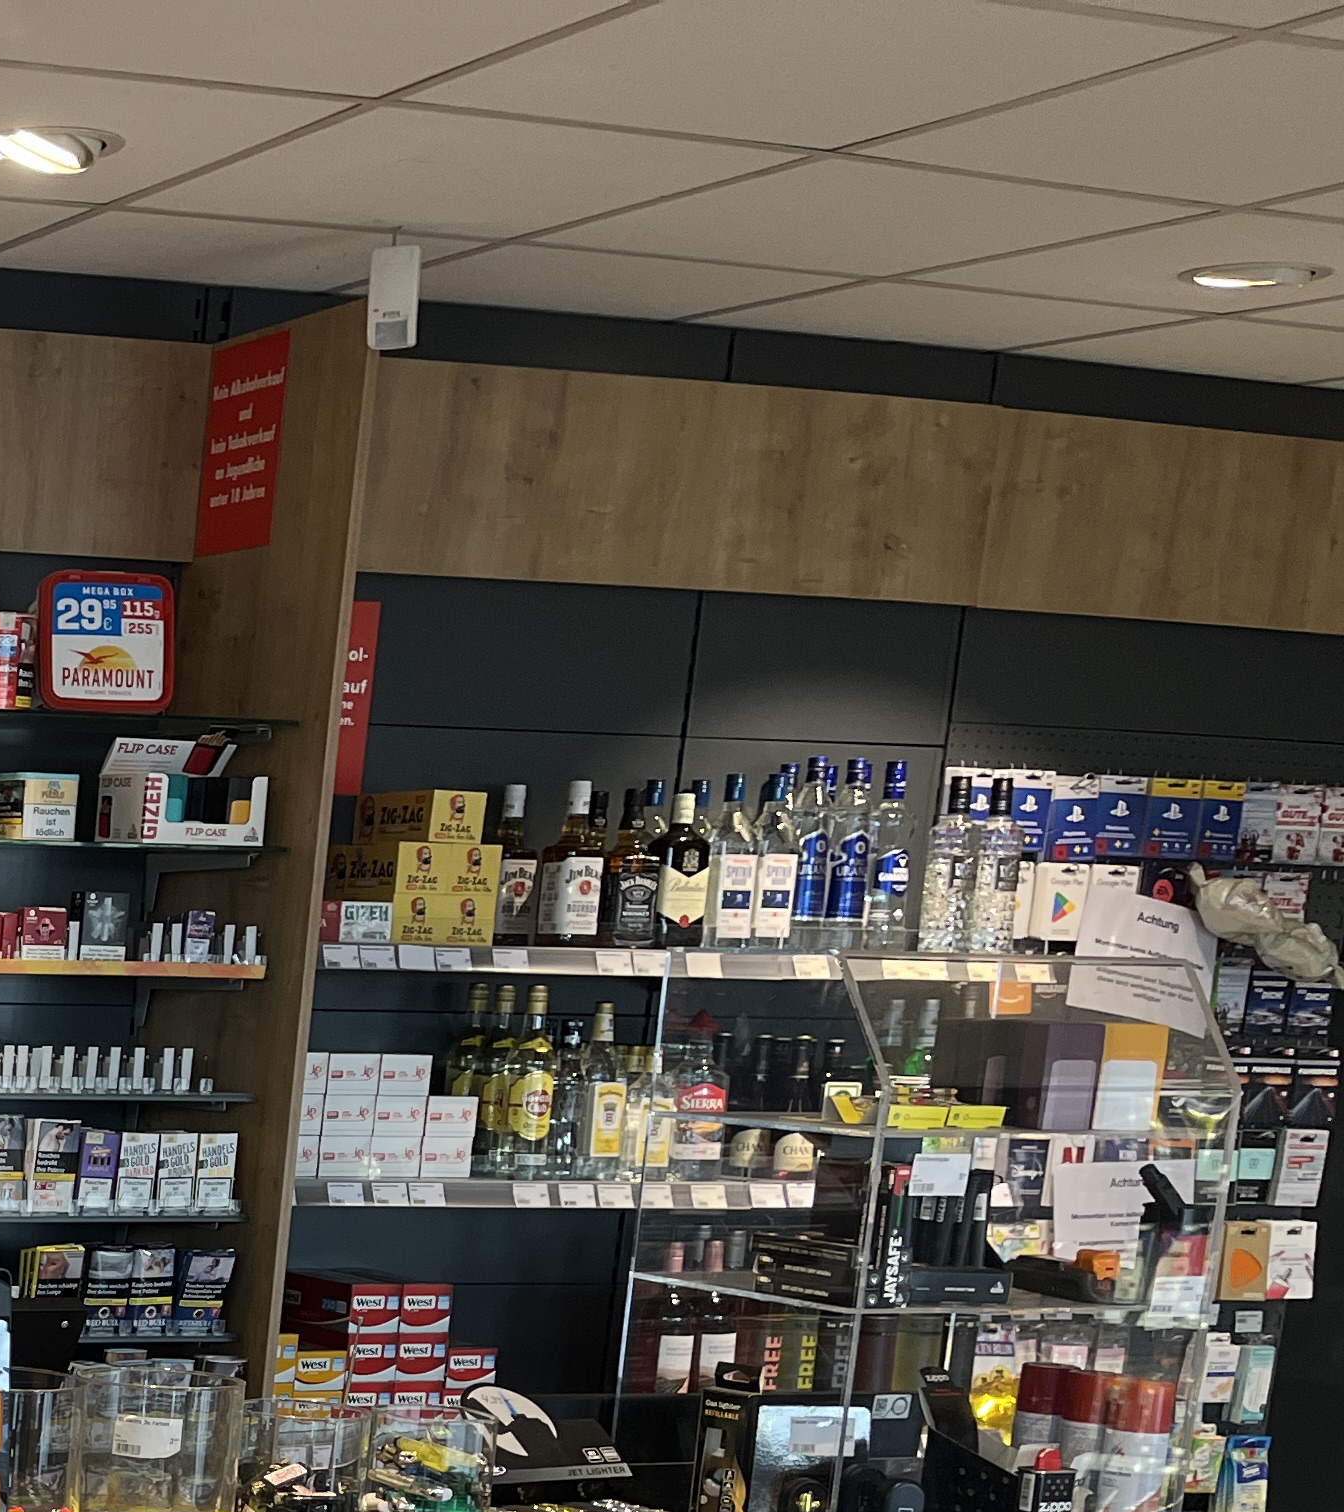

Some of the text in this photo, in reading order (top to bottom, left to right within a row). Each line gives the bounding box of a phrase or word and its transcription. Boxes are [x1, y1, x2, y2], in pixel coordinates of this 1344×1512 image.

[82, 586, 134, 597] MEGA BOX
[55, 598, 103, 631] 29
[128, 622, 153, 635] 255
[61, 667, 154, 690] PARAMOUNT
[117, 742, 179, 756] FLIP CASE
[141, 777, 163, 840] GIZEH
[439, 822, 472, 833] ZIG-ZAG
[344, 904, 389, 922] GIZEH
[1137, 912, 1180, 934] Achtung
[679, 1096, 724, 1111] SIERRA
[354, 1296, 382, 1309] West
[451, 1355, 479, 1368] West
[585, 1465, 626, 1477] LIGHTER
